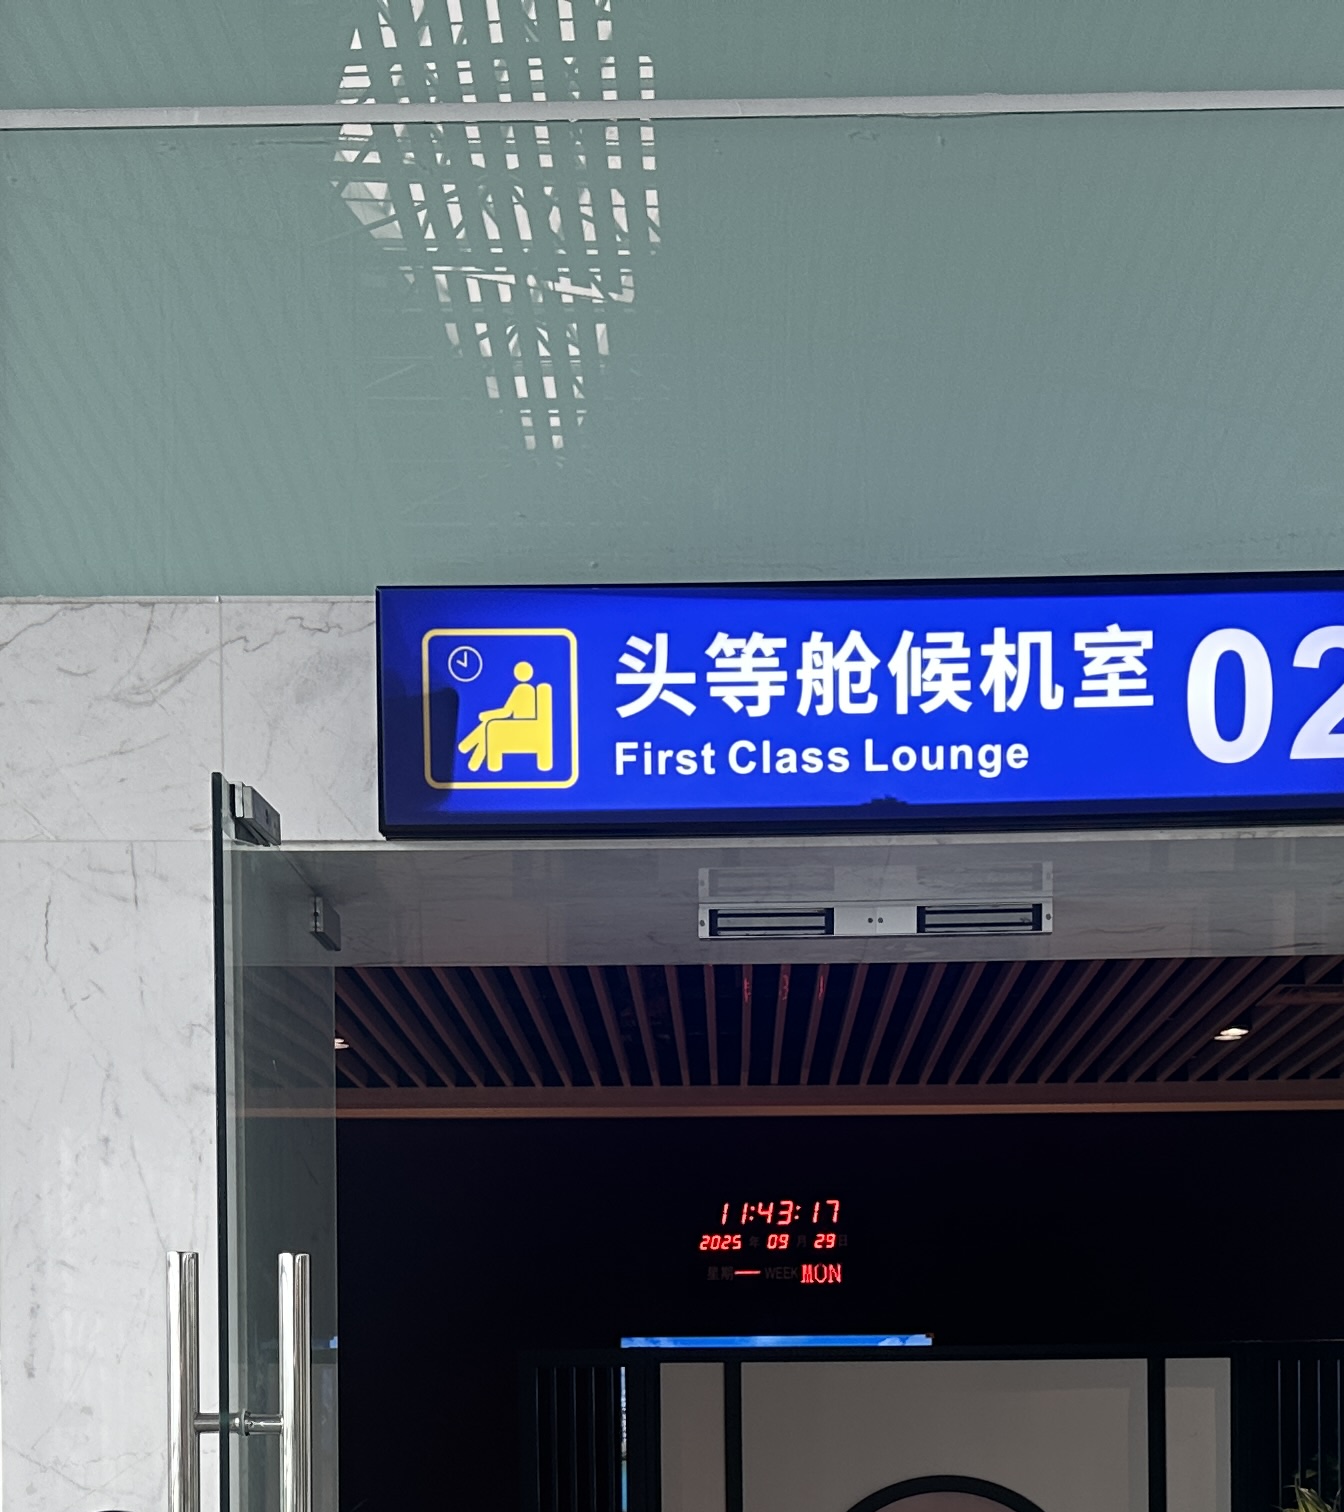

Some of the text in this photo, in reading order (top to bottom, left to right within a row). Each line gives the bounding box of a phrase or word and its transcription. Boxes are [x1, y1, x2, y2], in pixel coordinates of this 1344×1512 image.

[614, 622, 1156, 721] 头等舱候机室
[614, 735, 1030, 781] First Class Lounge
[699, 1233, 743, 1251] 2025
[766, 1233, 790, 1250] 09
[813, 1233, 837, 1250] 29
[800, 1263, 842, 1284] MON
